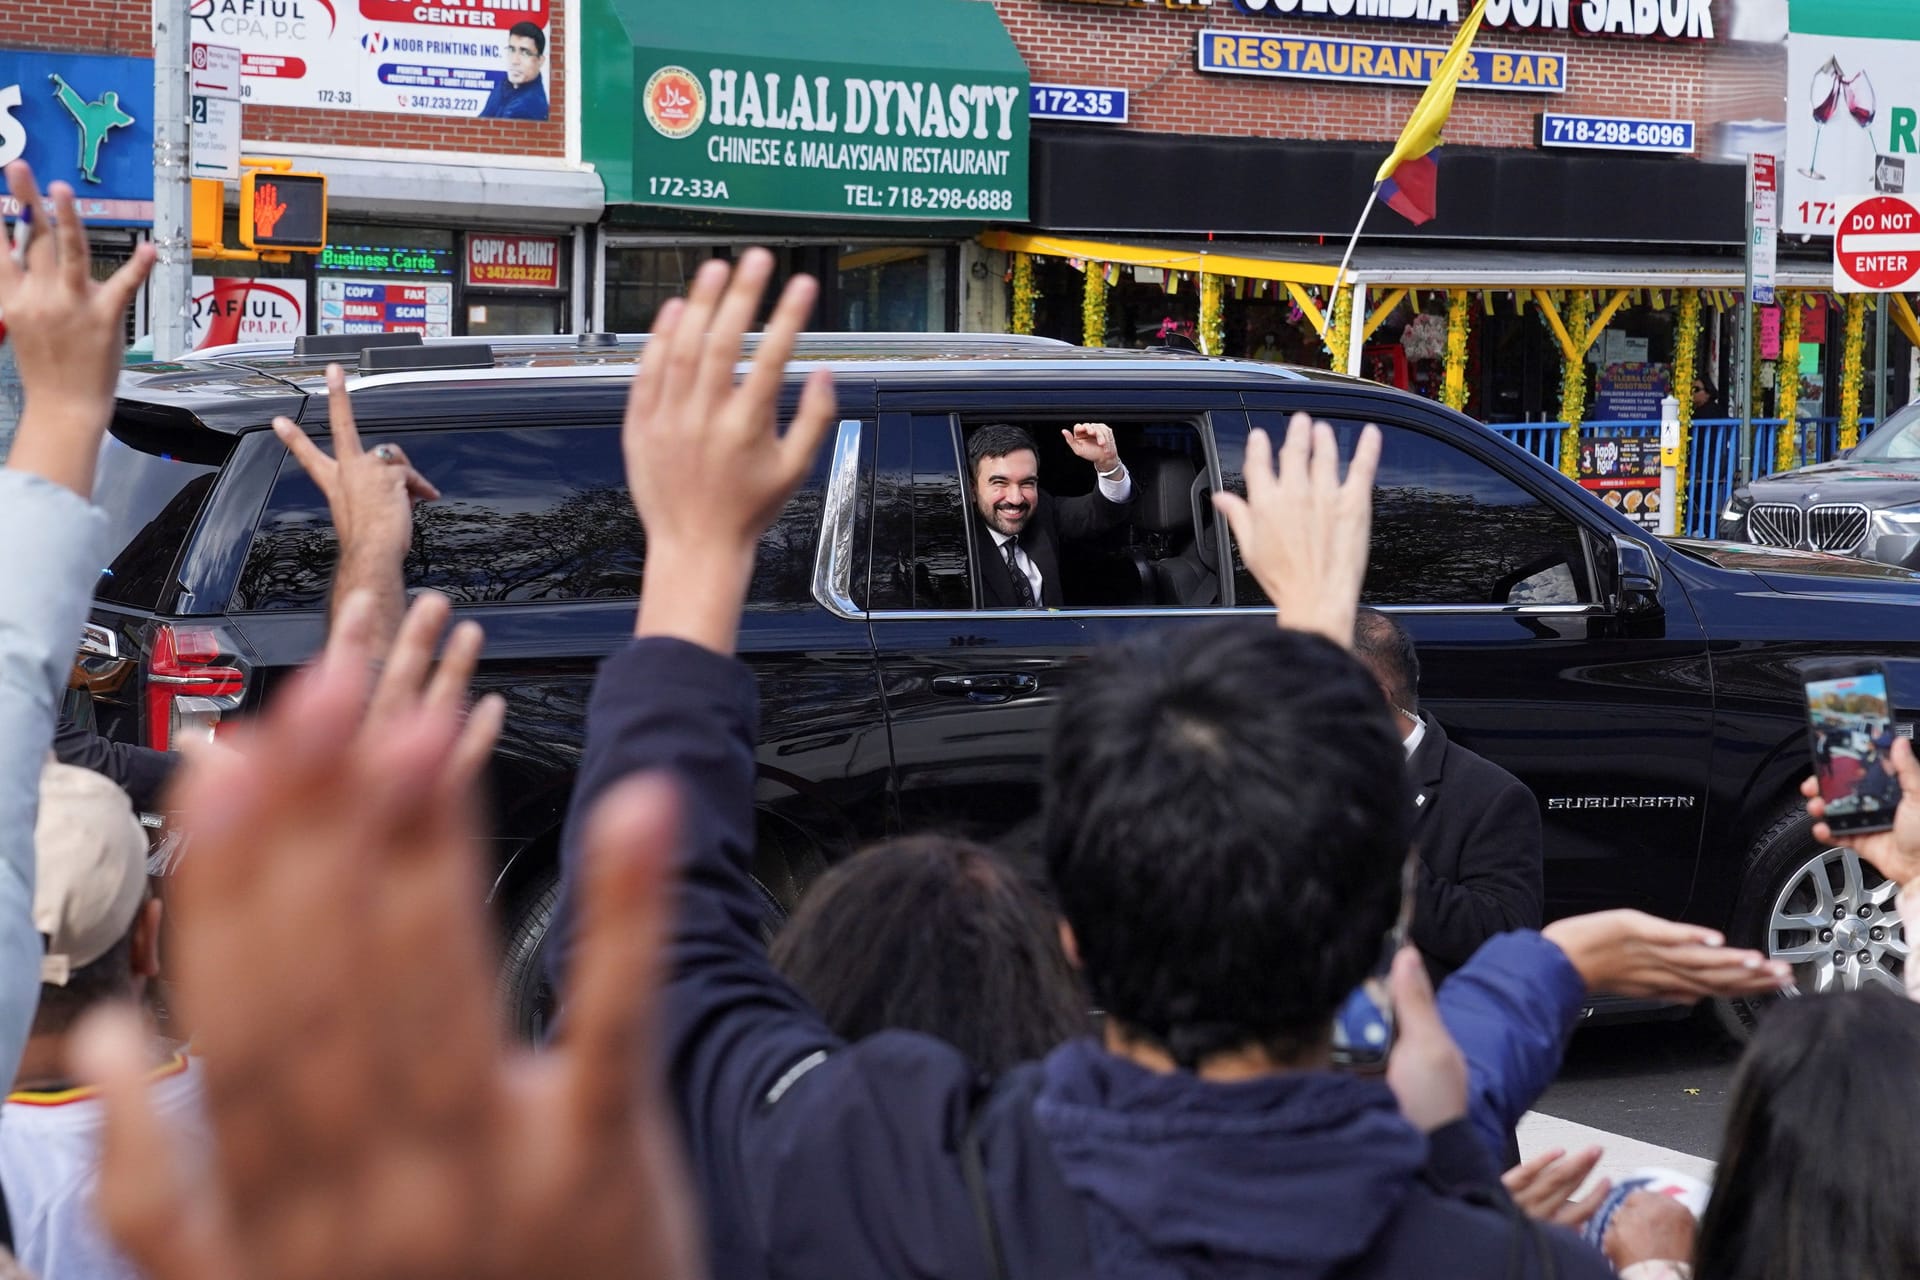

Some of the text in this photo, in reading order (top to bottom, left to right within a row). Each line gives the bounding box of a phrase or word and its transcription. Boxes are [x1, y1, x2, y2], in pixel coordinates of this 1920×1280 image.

[413, 7, 496, 27] CENTER
[393, 37, 502, 58] NOOR PRINTING INC.
[1492, 54, 1559, 86] BAR
[318, 90, 352, 103] 172-33
[708, 68, 837, 133] HALAL
[844, 78, 1019, 140] DYNASTY
[1035, 90, 1113, 115] 172-35
[1551, 120, 1685, 146] 718-298-6096
[707, 135, 1010, 175] CHINESE & MALAYSIAN RESTAURANT
[649, 177, 729, 199] 172-33A
[844, 185, 1013, 210] TEL: 718-298-6888
[1852, 213, 1912, 230] DO NOT
[322, 249, 435, 269] Business Cards
[472, 239, 555, 266] COPY & PRINT
[1855, 256, 1908, 272] ENTER
[345, 286, 424, 300] COPY FAX
[345, 304, 425, 318] EMAIL SCAN
[1548, 796, 1695, 809] SUBURBAN
